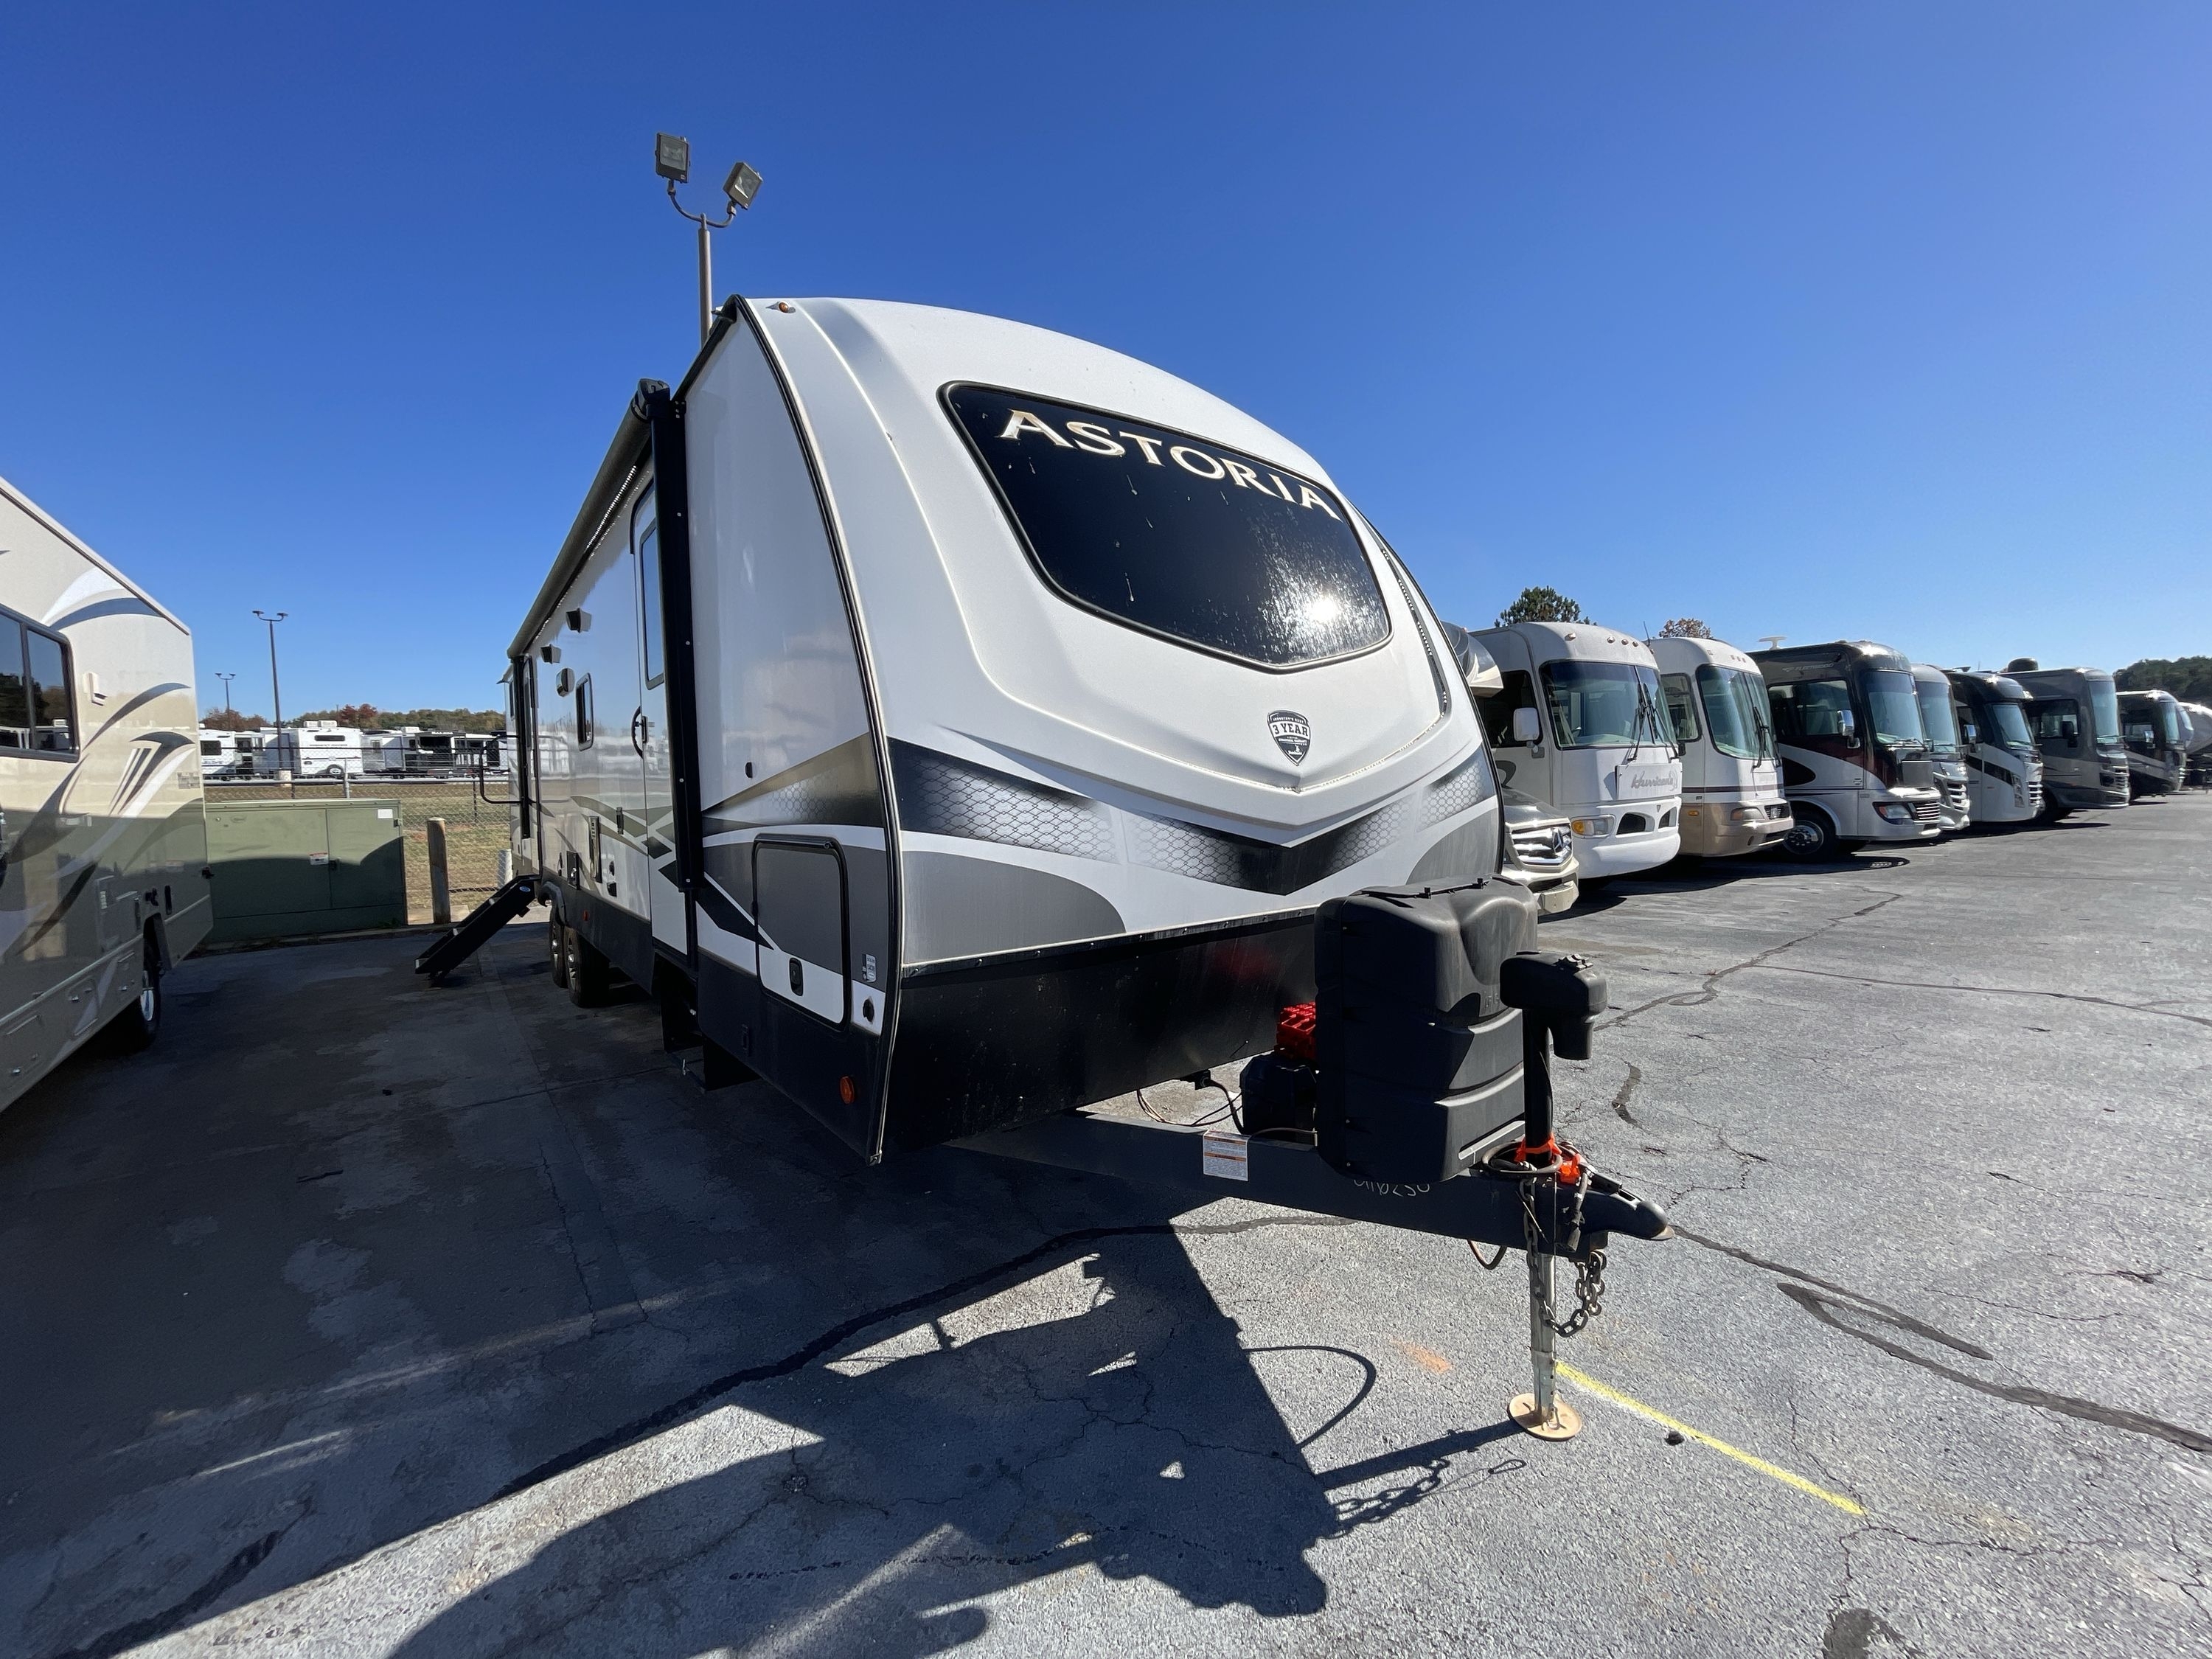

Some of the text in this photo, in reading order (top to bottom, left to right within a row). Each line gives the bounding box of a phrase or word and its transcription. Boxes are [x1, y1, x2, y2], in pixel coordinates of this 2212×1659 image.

[995, 408, 1344, 523] ASTORIA
[1273, 723, 1308, 737] 3 YEAR
